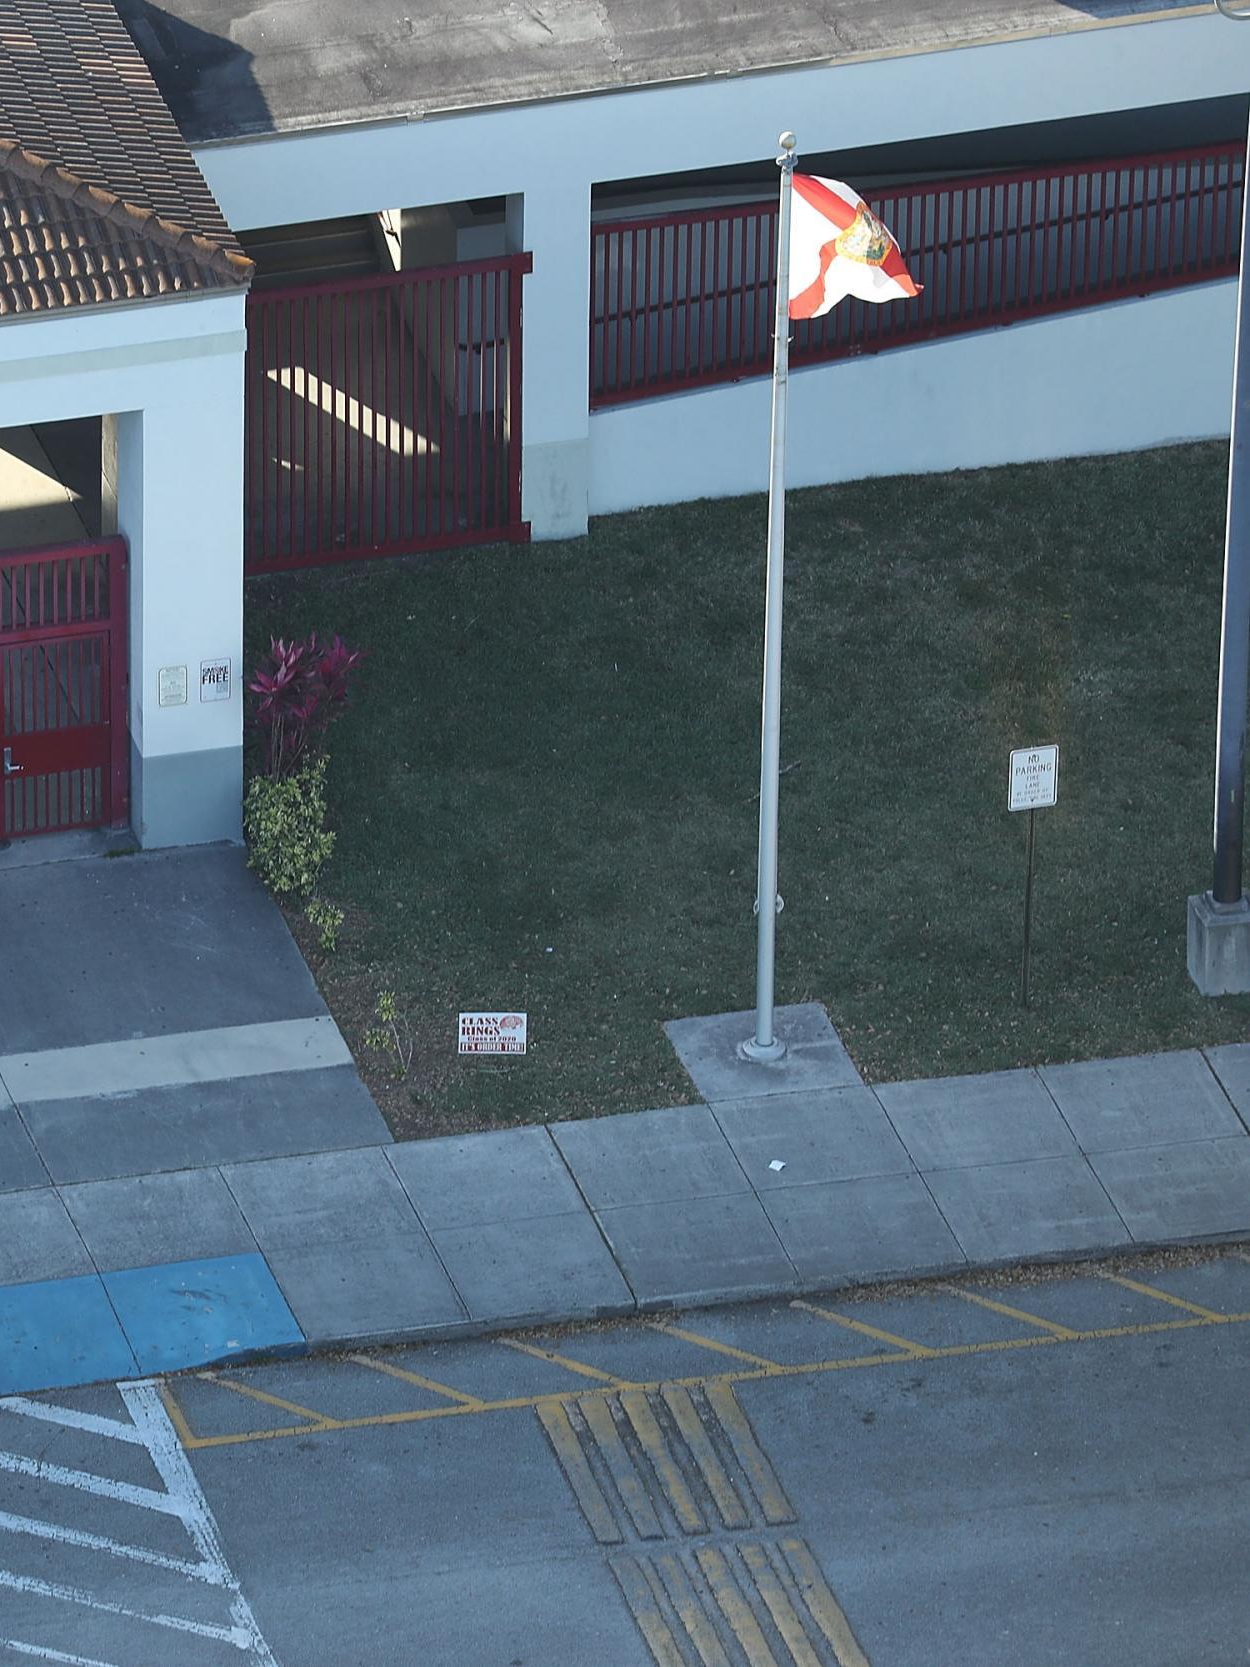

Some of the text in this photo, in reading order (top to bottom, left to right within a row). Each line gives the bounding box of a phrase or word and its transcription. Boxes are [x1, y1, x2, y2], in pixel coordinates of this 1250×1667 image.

[202, 673, 228, 685] FREE
[1028, 754, 1040, 764] NO
[1015, 763, 1052, 776] PARKING
[461, 1017, 499, 1026] CLASS
[461, 1026, 500, 1036] RINGS
[478, 1042, 502, 1052] ORDER
